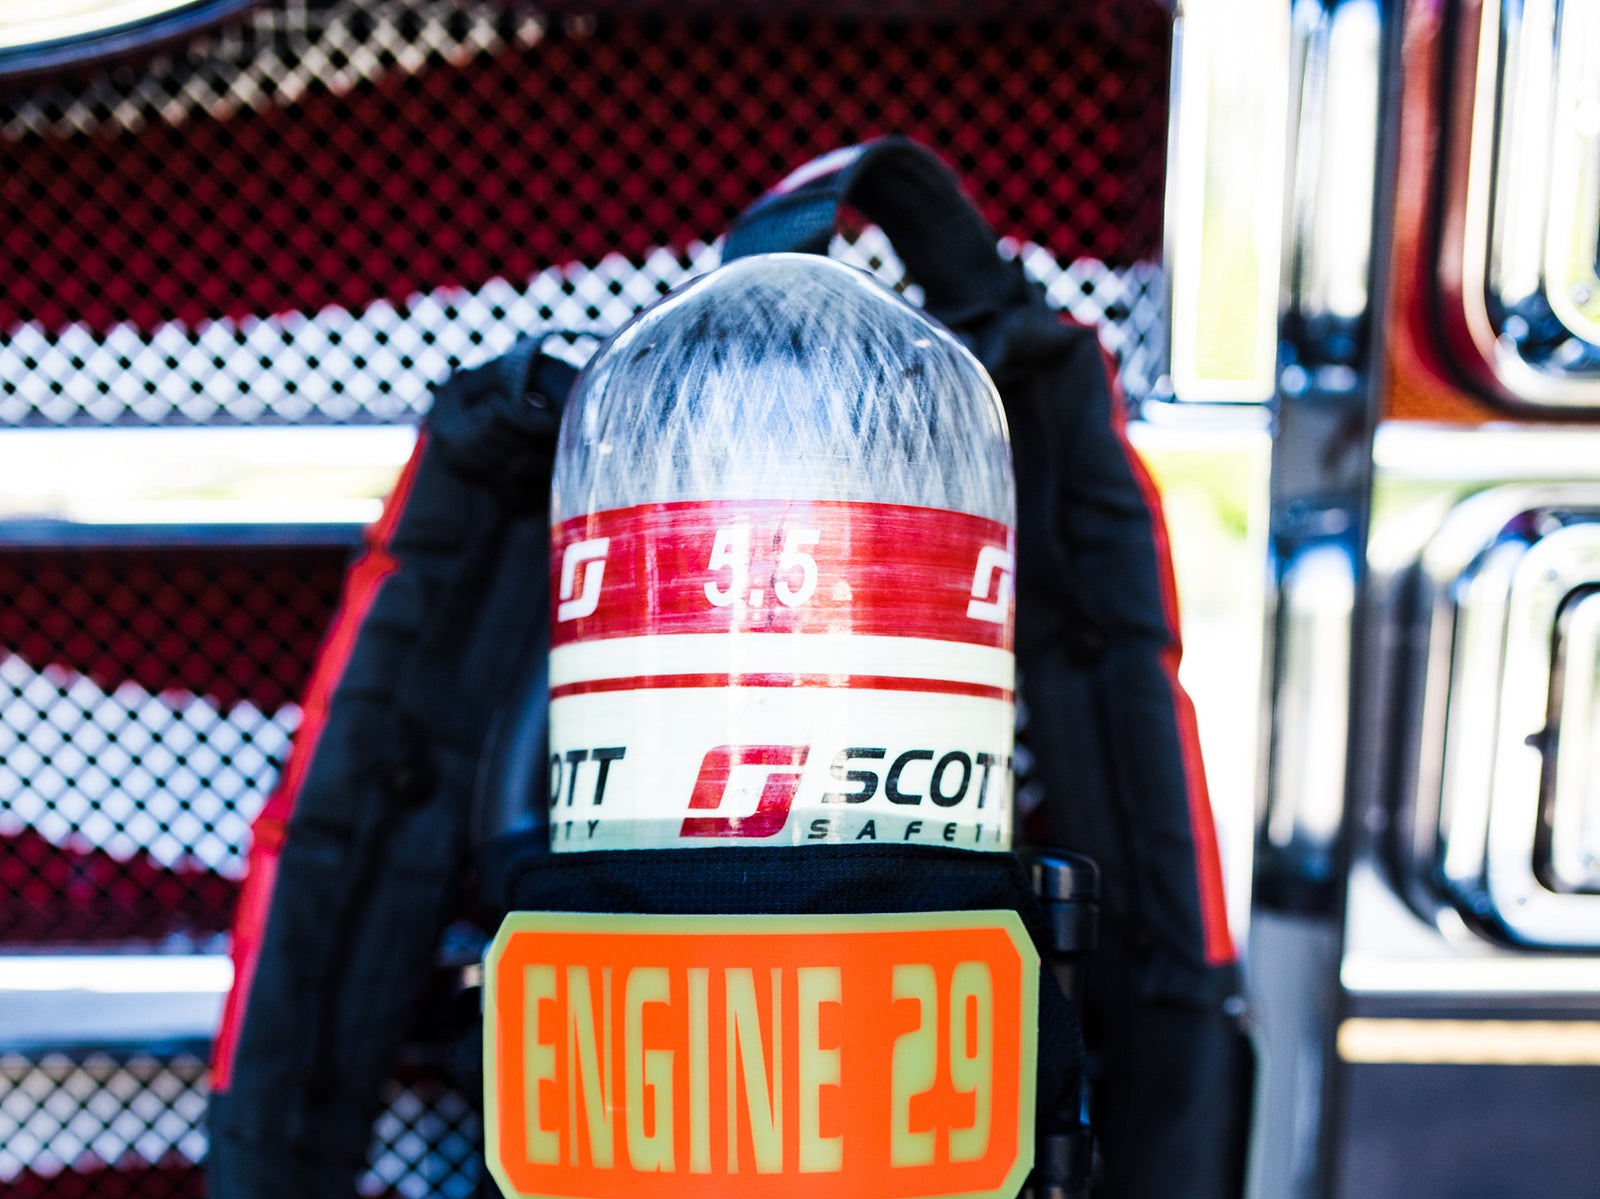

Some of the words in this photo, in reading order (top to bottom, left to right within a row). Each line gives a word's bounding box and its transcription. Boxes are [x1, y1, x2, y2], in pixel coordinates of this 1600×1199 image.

[703, 528, 821, 609] 5.5
[821, 747, 1012, 807] SCOT
[523, 964, 844, 1174] ENGINE
[891, 960, 994, 1168] 29
